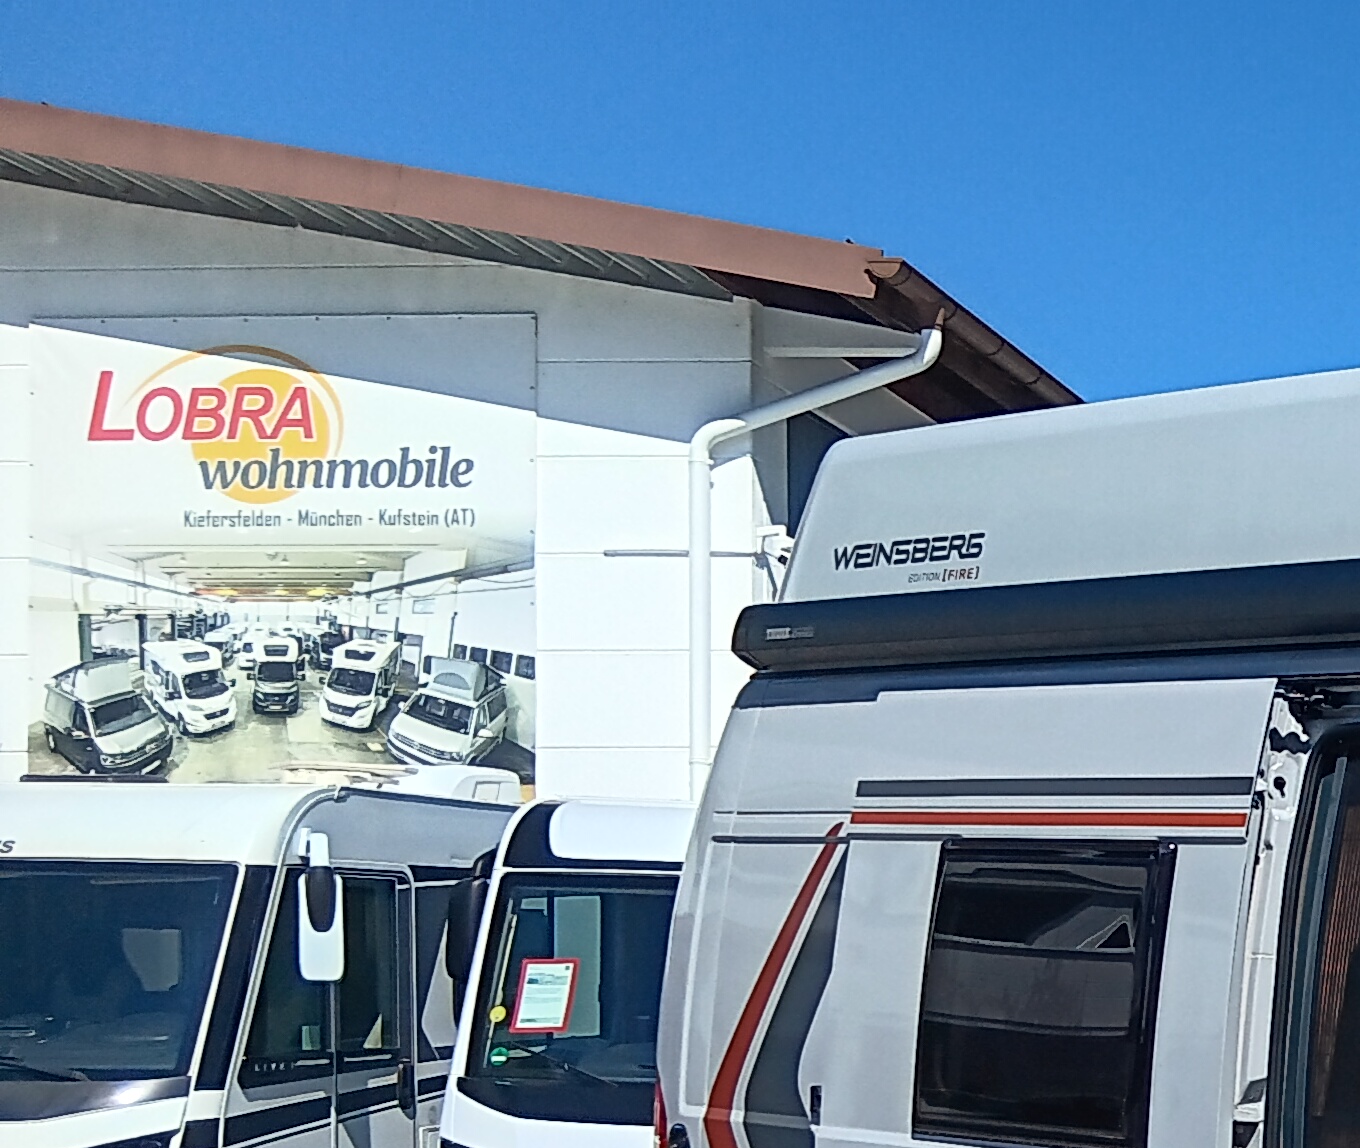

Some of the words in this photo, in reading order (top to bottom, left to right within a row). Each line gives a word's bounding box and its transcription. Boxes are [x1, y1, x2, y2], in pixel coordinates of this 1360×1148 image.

[87, 371, 313, 441] LOBRA
[199, 446, 475, 490] wohnmobile
[184, 509, 281, 528] Kiefersfelden
[298, 509, 362, 527] München
[379, 508, 439, 527] Kufstein
[444, 508, 475, 527] (AT)
[834, 533, 986, 571] WEINSBERG
[0, 840, 16, 853] S
